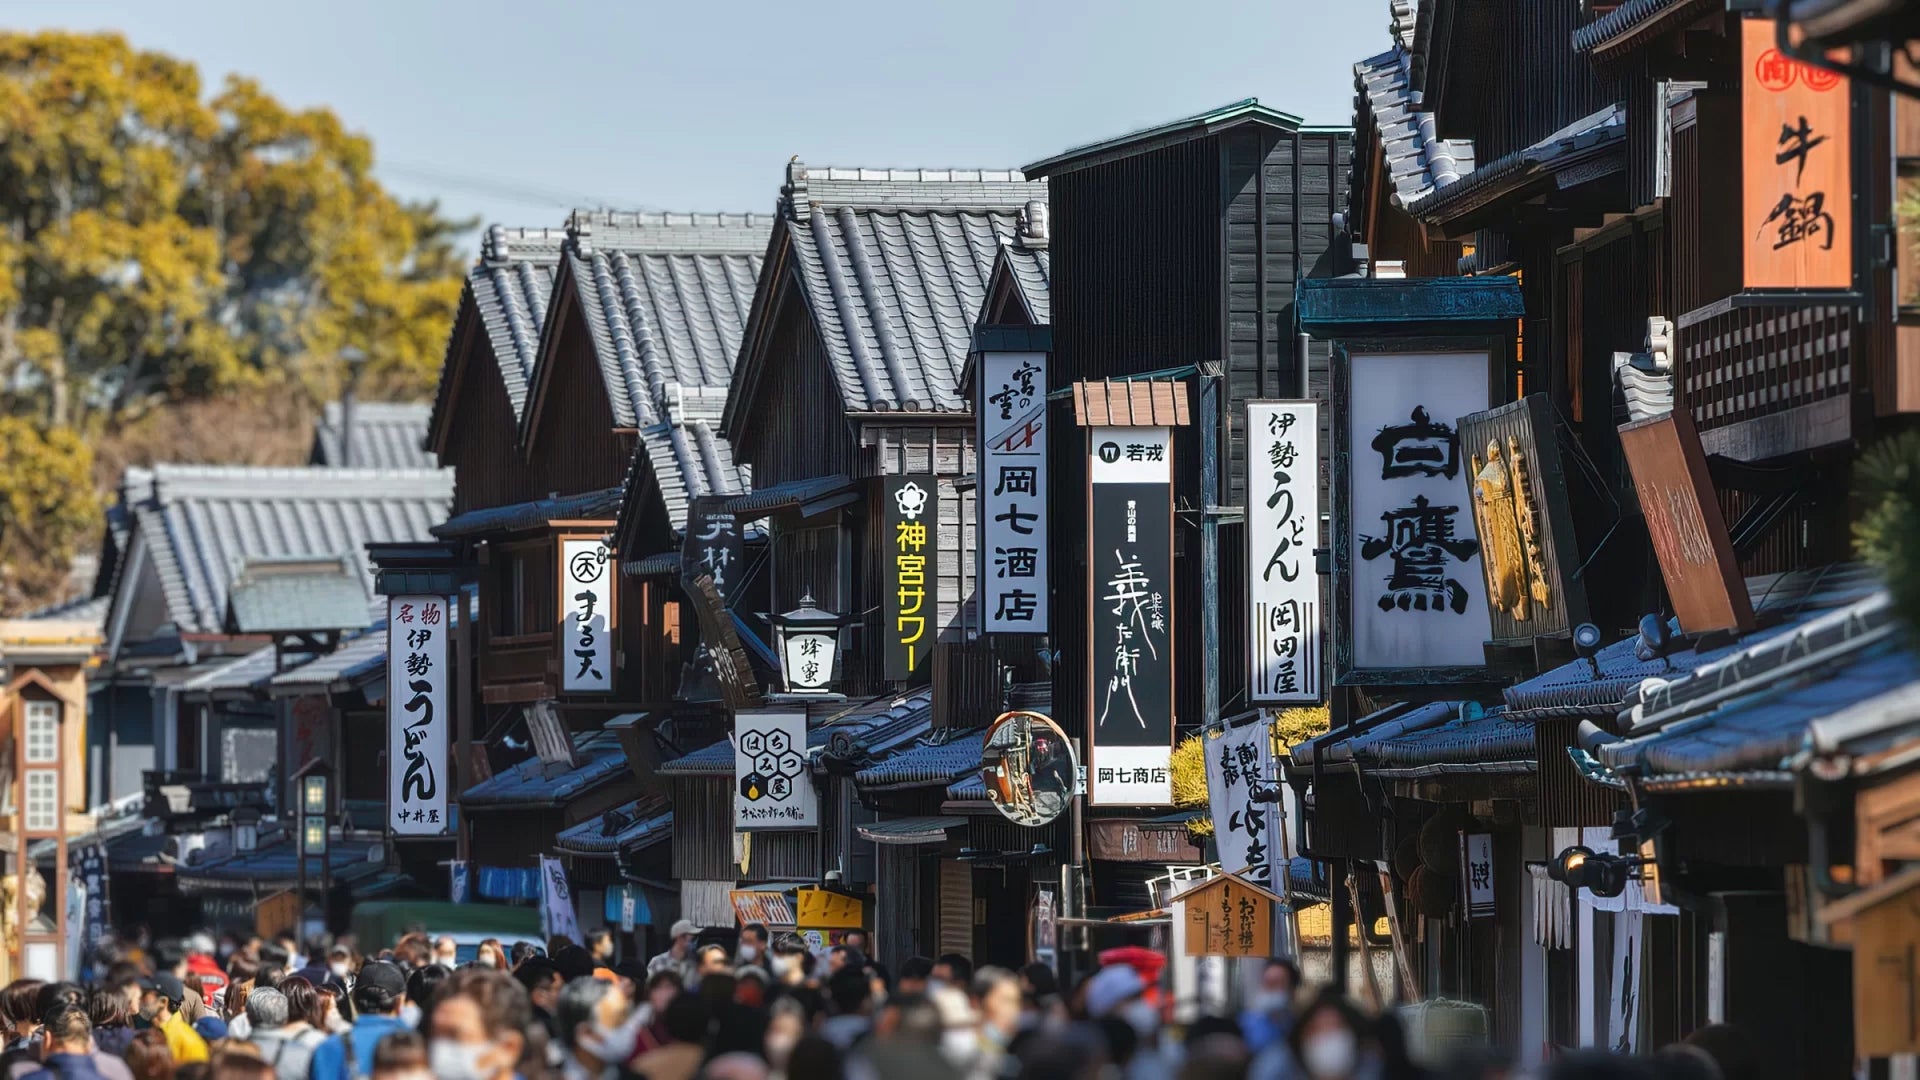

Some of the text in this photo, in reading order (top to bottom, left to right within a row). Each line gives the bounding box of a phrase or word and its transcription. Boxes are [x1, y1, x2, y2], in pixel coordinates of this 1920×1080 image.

[1756, 115, 1835, 251] 牛鍋
[1126, 443, 1164, 462] 若戎
[993, 464, 1038, 622] 岡七酒店
[1358, 404, 1478, 615] 白鷹
[1263, 412, 1306, 695] 伊勢うどん 岡田屋
[395, 602, 442, 625] 名物
[896, 520, 927, 672] 神宮サワー
[573, 589, 604, 681] まる天
[800, 637, 823, 683] 蜂蜜
[401, 628, 437, 804] 伊勢うどん
[1098, 766, 1167, 784] 岡七商店
[398, 808, 441, 825] 中井屋
[1221, 899, 1234, 954] もうすぐ
[1239, 896, 1258, 954] おかげ横丁
